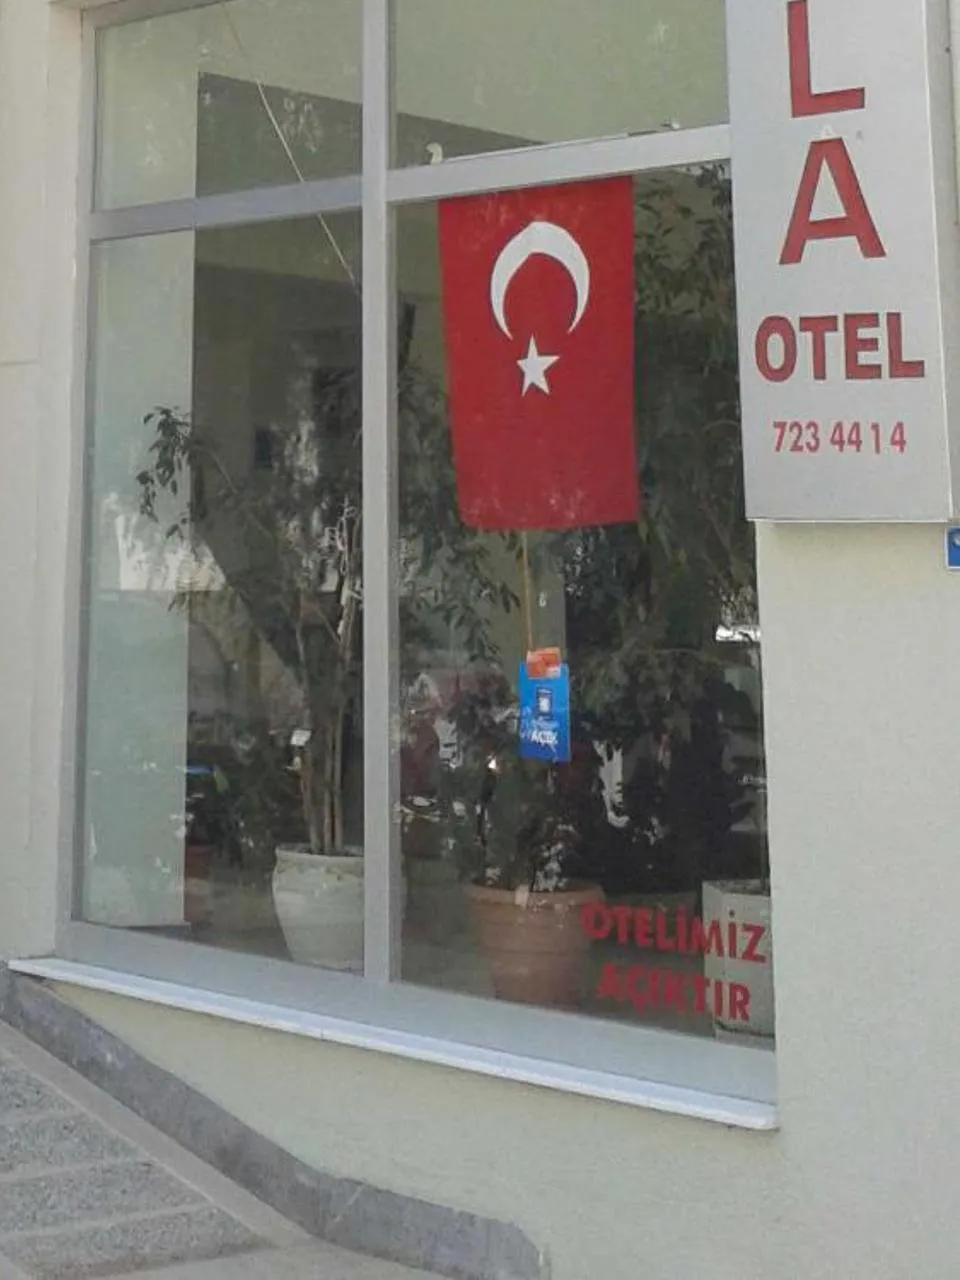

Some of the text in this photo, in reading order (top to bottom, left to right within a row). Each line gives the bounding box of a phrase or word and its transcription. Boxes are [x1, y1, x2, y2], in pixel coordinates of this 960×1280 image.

[754, 311, 925, 383] OTEL
[772, 420, 821, 453] 723
[578, 898, 767, 964] OTELİMİZ
[596, 961, 752, 1022] AÇIKTIR
